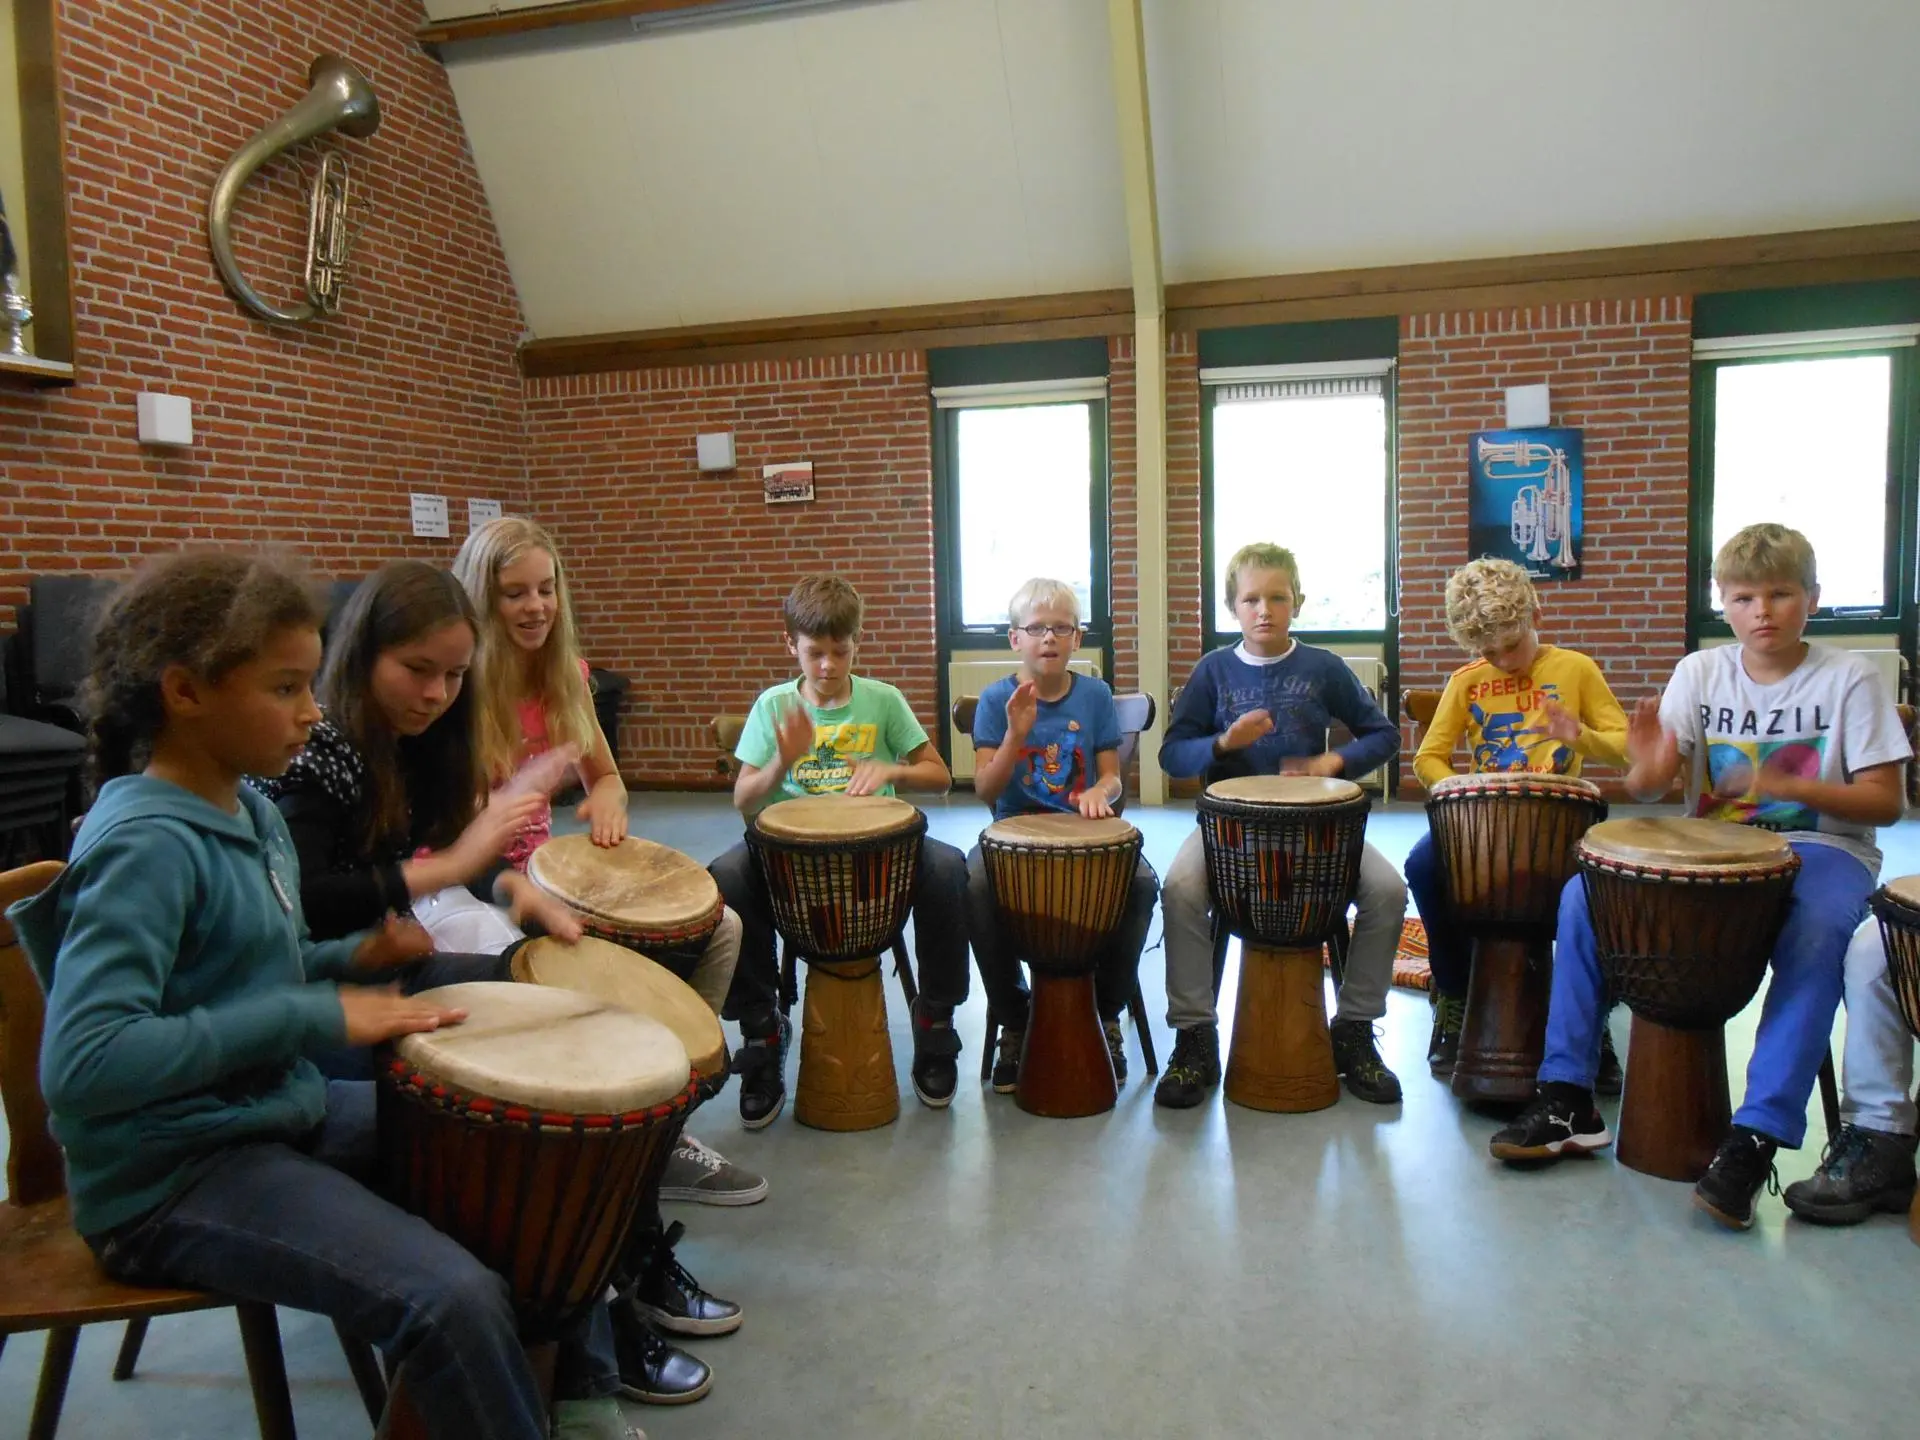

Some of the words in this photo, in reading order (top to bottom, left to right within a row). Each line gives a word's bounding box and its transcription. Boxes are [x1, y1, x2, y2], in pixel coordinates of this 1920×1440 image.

[1468, 676, 1533, 701] SPEED
[1516, 690, 1546, 712] UP
[1700, 704, 1830, 735] BRAZIL
